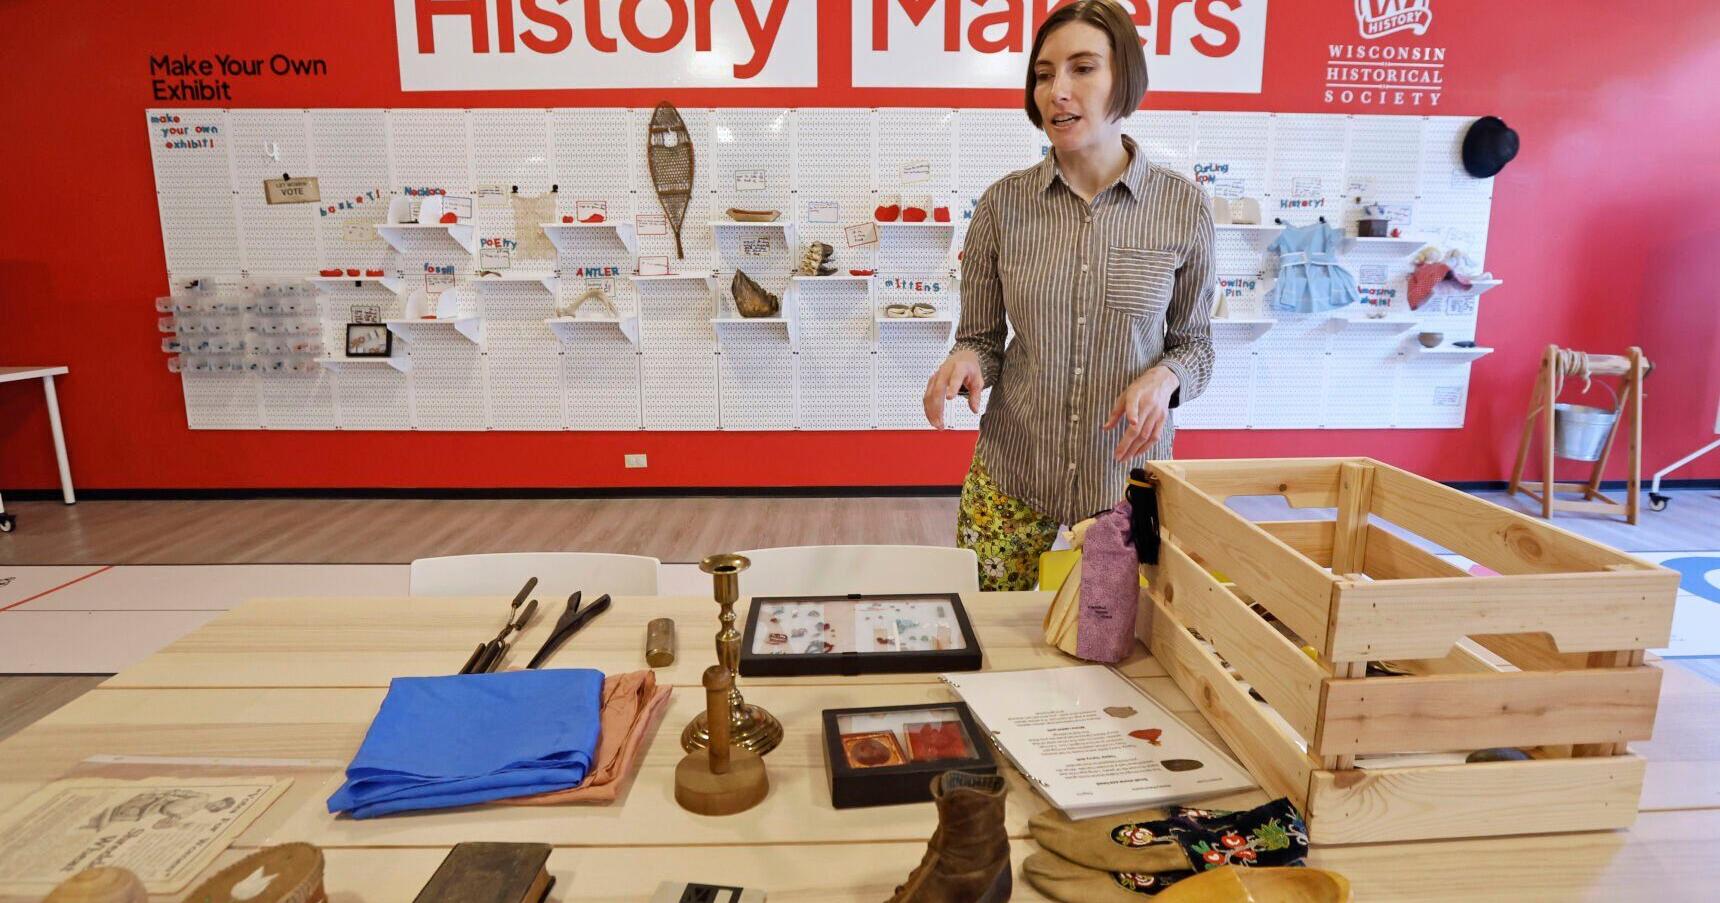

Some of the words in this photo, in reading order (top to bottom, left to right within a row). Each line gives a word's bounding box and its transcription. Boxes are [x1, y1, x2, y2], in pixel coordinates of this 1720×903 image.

[1368, 11, 1422, 34] HISTORY
[414, 0, 790, 79] History
[1328, 44, 1446, 61] WISCONSIN
[150, 55, 213, 76] Make
[215, 54, 264, 76] Your
[269, 54, 327, 76] Own
[1326, 67, 1443, 83] HISTORICAL
[152, 79, 232, 101] Exhibit
[1324, 89, 1441, 106] SOCIETY
[280, 187, 304, 196] VOTE
